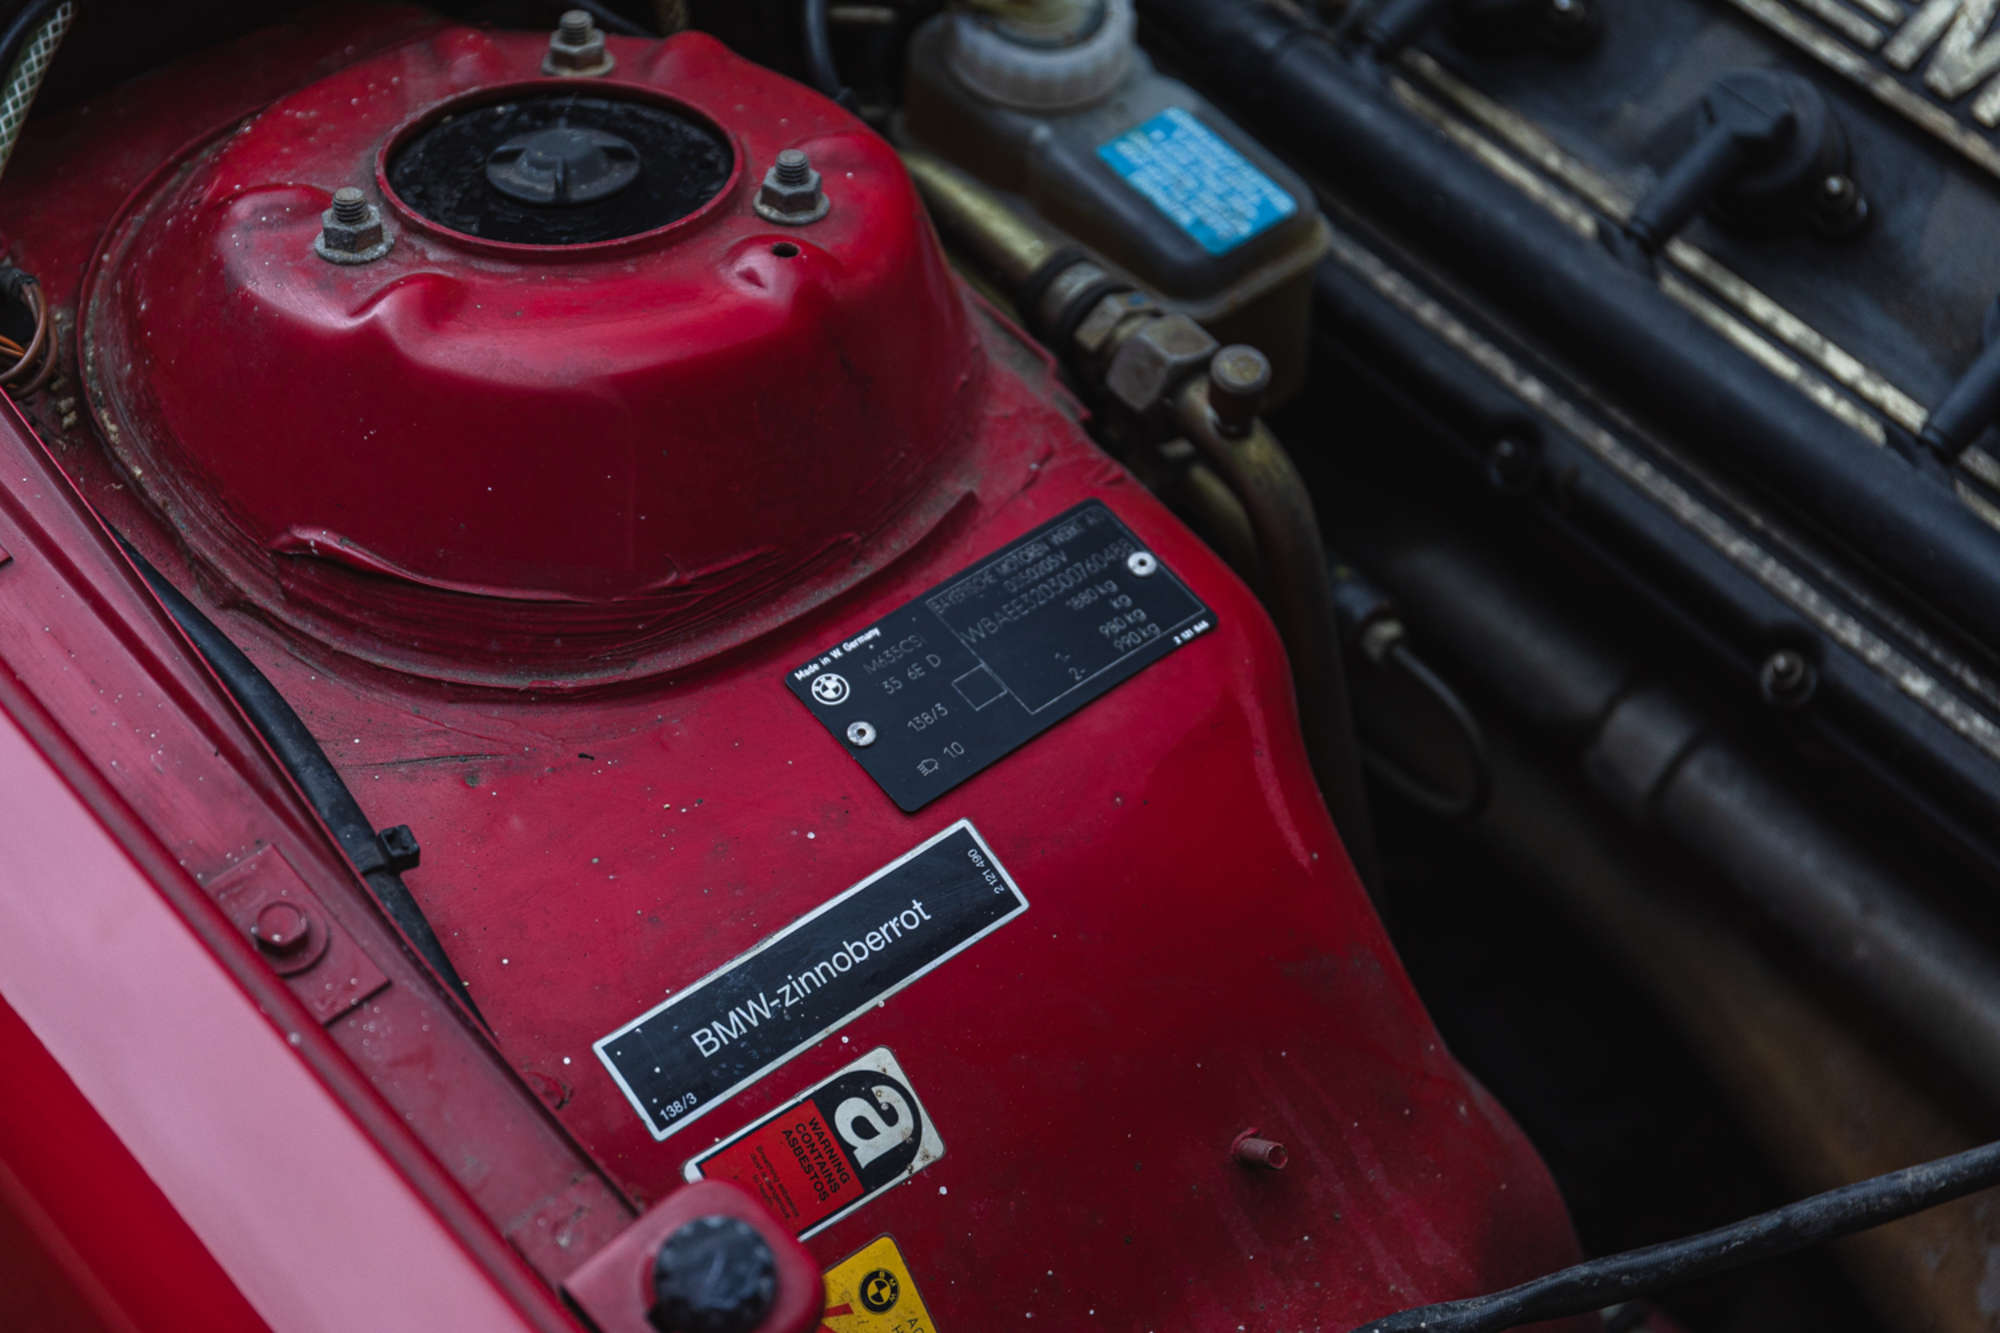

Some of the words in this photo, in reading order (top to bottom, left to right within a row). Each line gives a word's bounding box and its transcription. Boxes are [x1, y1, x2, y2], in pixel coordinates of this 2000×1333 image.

[1095, 580, 1118, 595] kg
[1110, 594, 1132, 609] kg
[1099, 617, 1127, 637] 980
[1124, 608, 1147, 624] kg
[1113, 631, 1142, 651] 990
[1138, 623, 1162, 641] kg
[794, 663, 820, 680] Made
[819, 656, 831, 666] in
[842, 627, 880, 652] Germany
[882, 676, 903, 695] 35
[907, 662, 925, 680] 6E
[925, 654, 942, 668] D
[907, 702, 948, 731] 138/3
[967, 848, 985, 867] 490
[982, 869, 998, 885] 121
[993, 884, 1005, 894] 2
[690, 898, 932, 1060] BMW-zinnoberrot
[660, 1092, 697, 1120] 138/3
[795, 1123, 841, 1194] CONTAINS
[809, 1117, 850, 1184] WARNING
[782, 1130, 830, 1202] ASBESTOS
